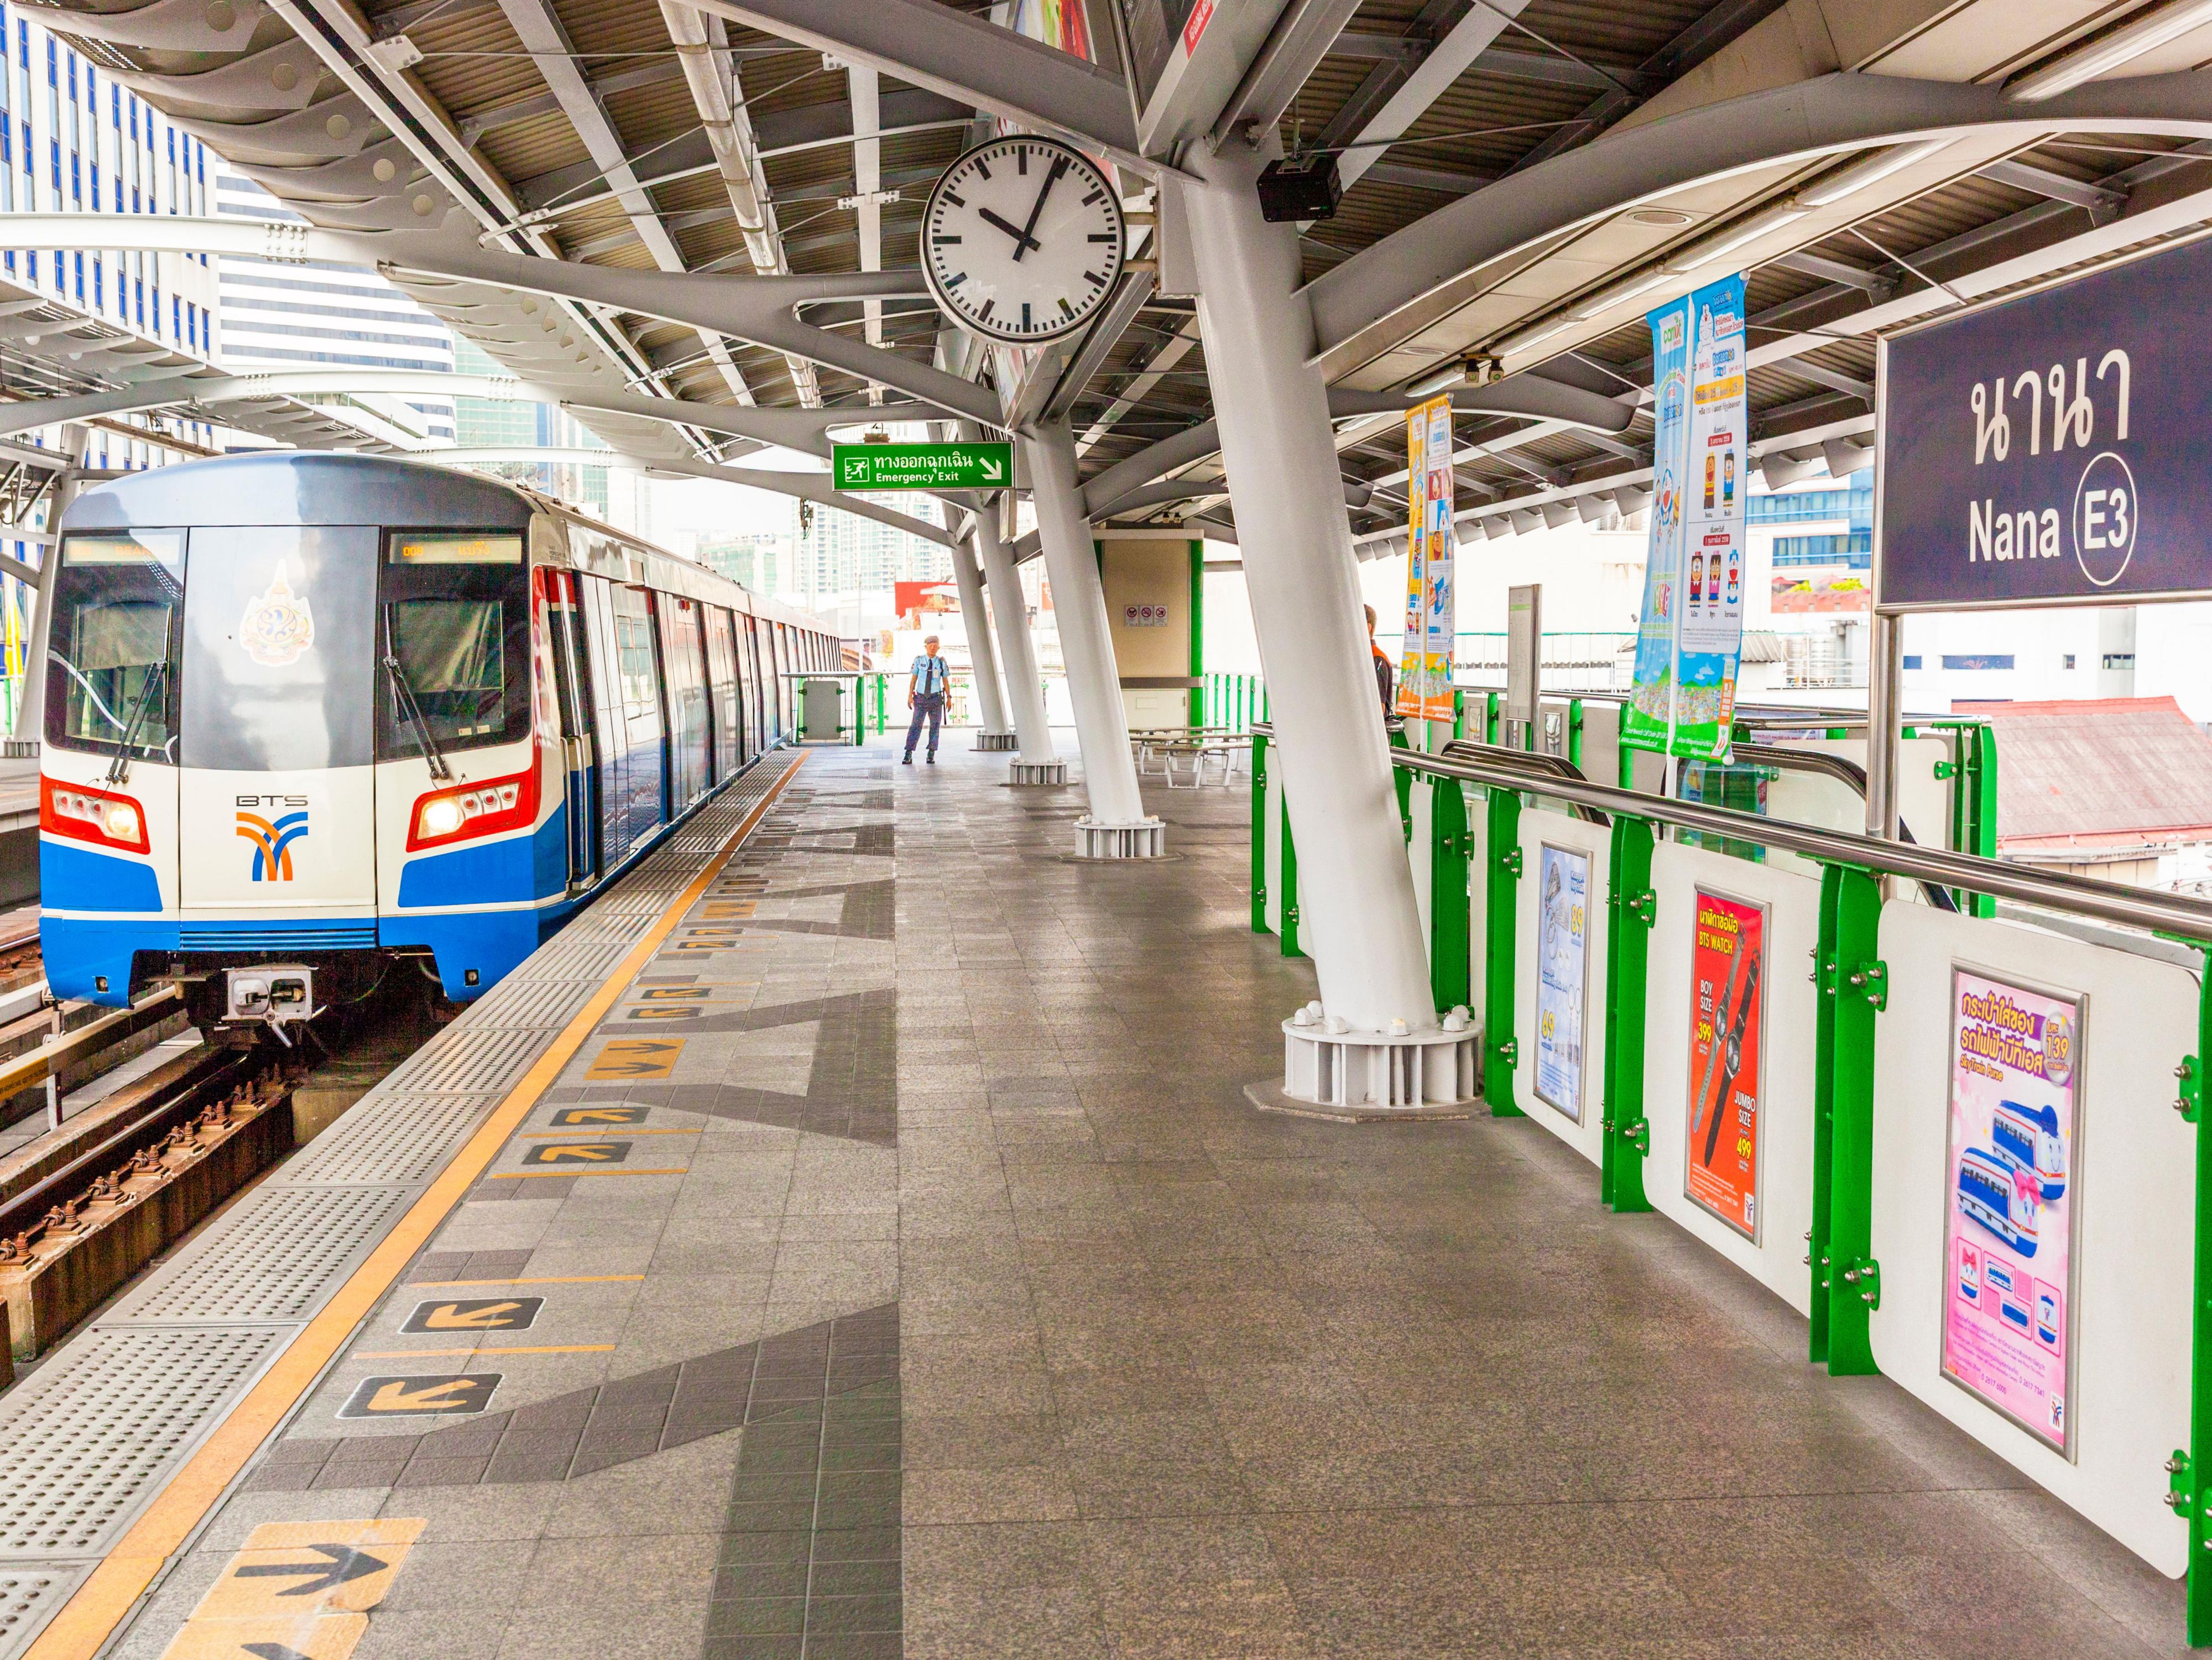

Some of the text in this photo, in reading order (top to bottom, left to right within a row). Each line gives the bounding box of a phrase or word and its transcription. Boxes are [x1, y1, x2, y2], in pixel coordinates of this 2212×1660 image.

[1971, 349, 2130, 465] นานา
[874, 450, 973, 474] ทางออกฉุกเฉิน
[876, 471, 959, 483] Emergency Exit
[1970, 488, 2128, 562] Nana E3
[236, 795, 308, 806] BTS
[1571, 903, 1584, 938] 89
[1699, 908, 1739, 934] นาฬิกาข้อมือ
[1699, 930, 1733, 955] BTS WATCH
[1700, 979, 1713, 996] BOY
[1700, 995, 1713, 1013] SIZE
[1961, 990, 2036, 1037] กระเป๋าใส่ของ
[1541, 1008, 1555, 1042] 69
[1698, 1021, 1712, 1043] 399
[1960, 1024, 2046, 1076] รถไฟฟ้าบีทีเอส
[2046, 1035, 2069, 1060] 139
[1960, 1053, 2004, 1081] SkyTrain Purse
[1734, 1090, 1756, 1113] JUMBO
[1738, 1108, 1751, 1128] SIZE
[1736, 1136, 1751, 1160] 499
